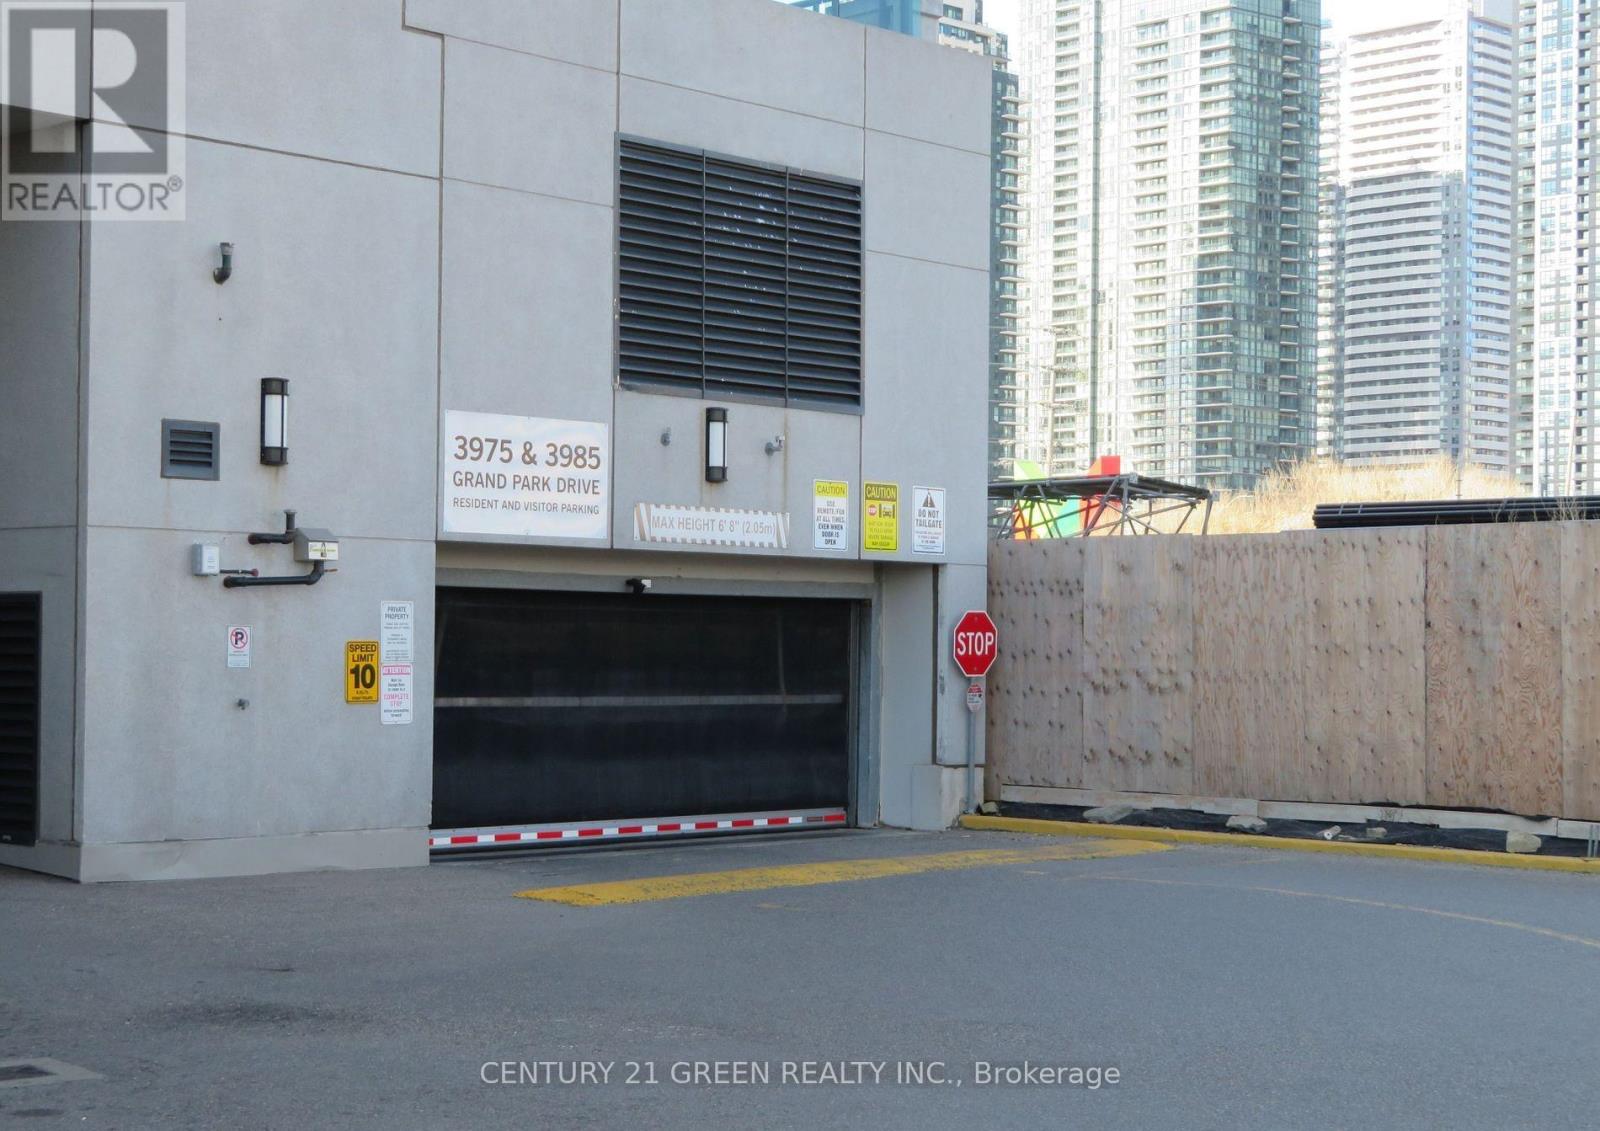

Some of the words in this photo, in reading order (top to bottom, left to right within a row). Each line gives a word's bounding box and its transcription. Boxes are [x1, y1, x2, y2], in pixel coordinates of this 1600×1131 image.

[454, 435, 513, 463] 3975
[521, 441, 538, 465] &
[545, 443, 600, 470] 3985
[453, 471, 507, 489] GRAND
[513, 475, 551, 492] PARK
[556, 478, 600, 495] DRIVE
[817, 485, 845, 495] CAUTION
[866, 486, 896, 500] CAUTION
[453, 497, 499, 509] RESIDENT
[502, 500, 521, 511] AND
[523, 502, 558, 512] VISITOR
[561, 504, 600, 515] PARKING
[918, 509, 927, 518] DO
[928, 510, 940, 519] NOT
[652, 516, 675, 529] MAX
[677, 517, 715, 531] HEIGHT
[718, 519, 727, 532] 6'
[729, 520, 739, 533] 8"
[742, 521, 776, 537] (2.05m)
[915, 518, 942, 529] TAILGATE
[349, 644, 377, 653] SPEED
[957, 631, 994, 656] STOP
[352, 653, 374, 663] LIMIT
[350, 663, 376, 689] 10
